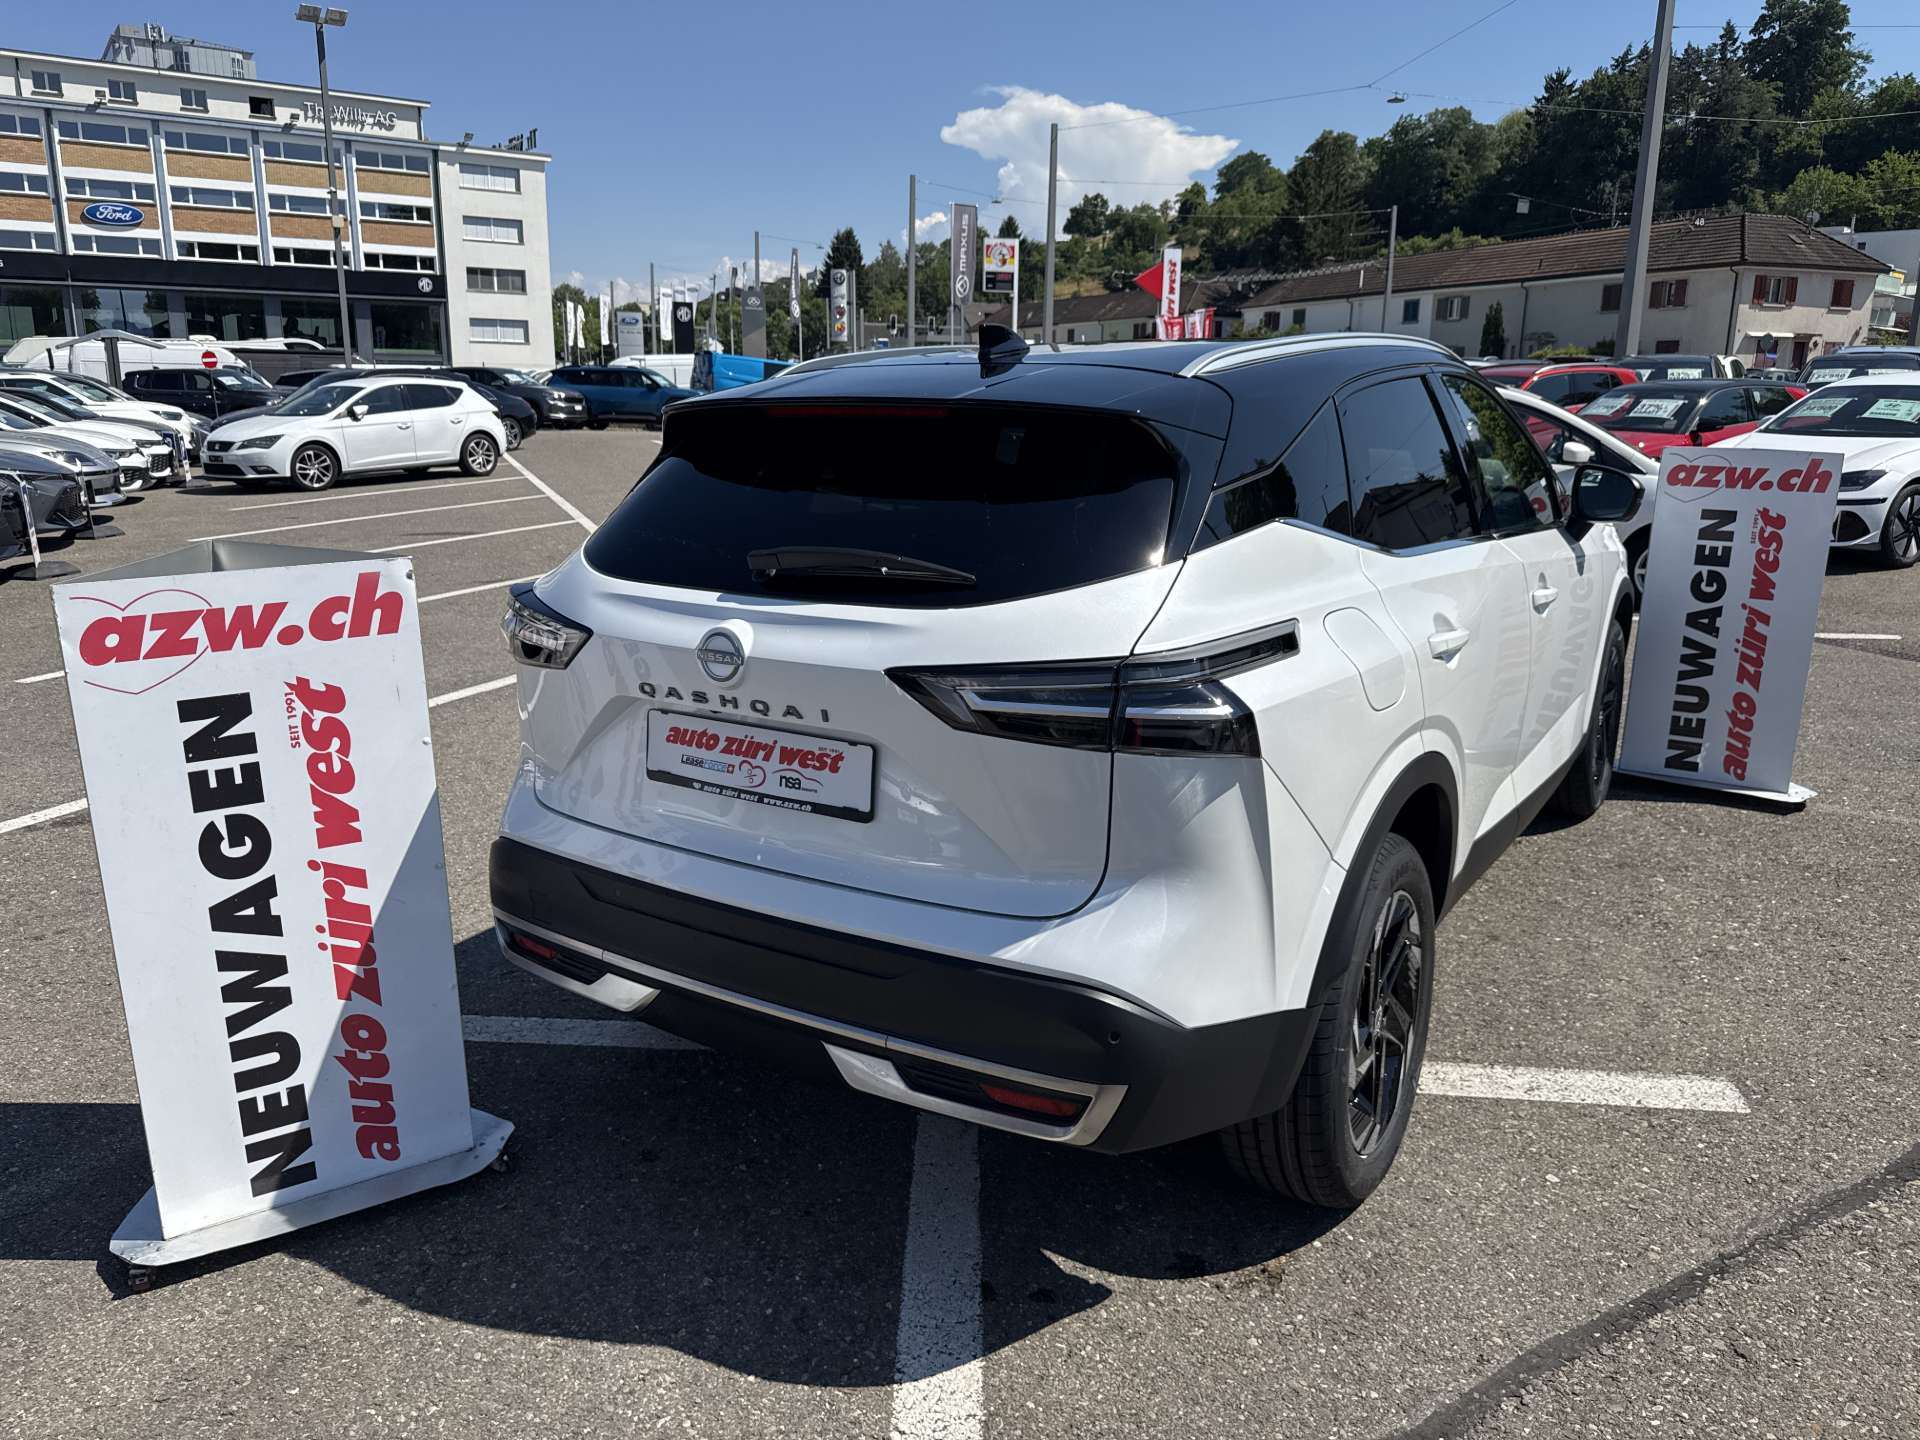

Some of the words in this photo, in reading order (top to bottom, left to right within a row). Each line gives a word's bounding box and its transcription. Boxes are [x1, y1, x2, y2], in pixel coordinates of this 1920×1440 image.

[304, 101, 334, 118] Th
[375, 110, 397, 125] AG
[96, 205, 132, 221] Ford
[960, 213, 969, 272] MAXUS
[418, 277, 433, 293] MG
[677, 306, 692, 322] MG
[1666, 458, 1832, 493] azw.ch
[1749, 507, 1786, 601] west
[79, 572, 404, 666] azw.ch
[1664, 508, 1738, 772] NEUWAGEN
[698, 652, 742, 665] NISSAN
[1734, 602, 1772, 693] züri
[285, 691, 297, 719] 1991
[639, 682, 830, 723] QASHQAI
[288, 724, 300, 748] SEIT
[665, 725, 720, 751] auto
[720, 735, 778, 762] züri
[779, 746, 845, 773] west
[1723, 691, 1757, 781] auto
[283, 676, 362, 849] west
[779, 774, 802, 791] nsa
[704, 785, 720, 795] auto
[740, 792, 759, 802] west
[177, 692, 318, 1198] NEUWAGEN
[307, 860, 383, 1006] züri
[334, 1014, 401, 1161] auto
